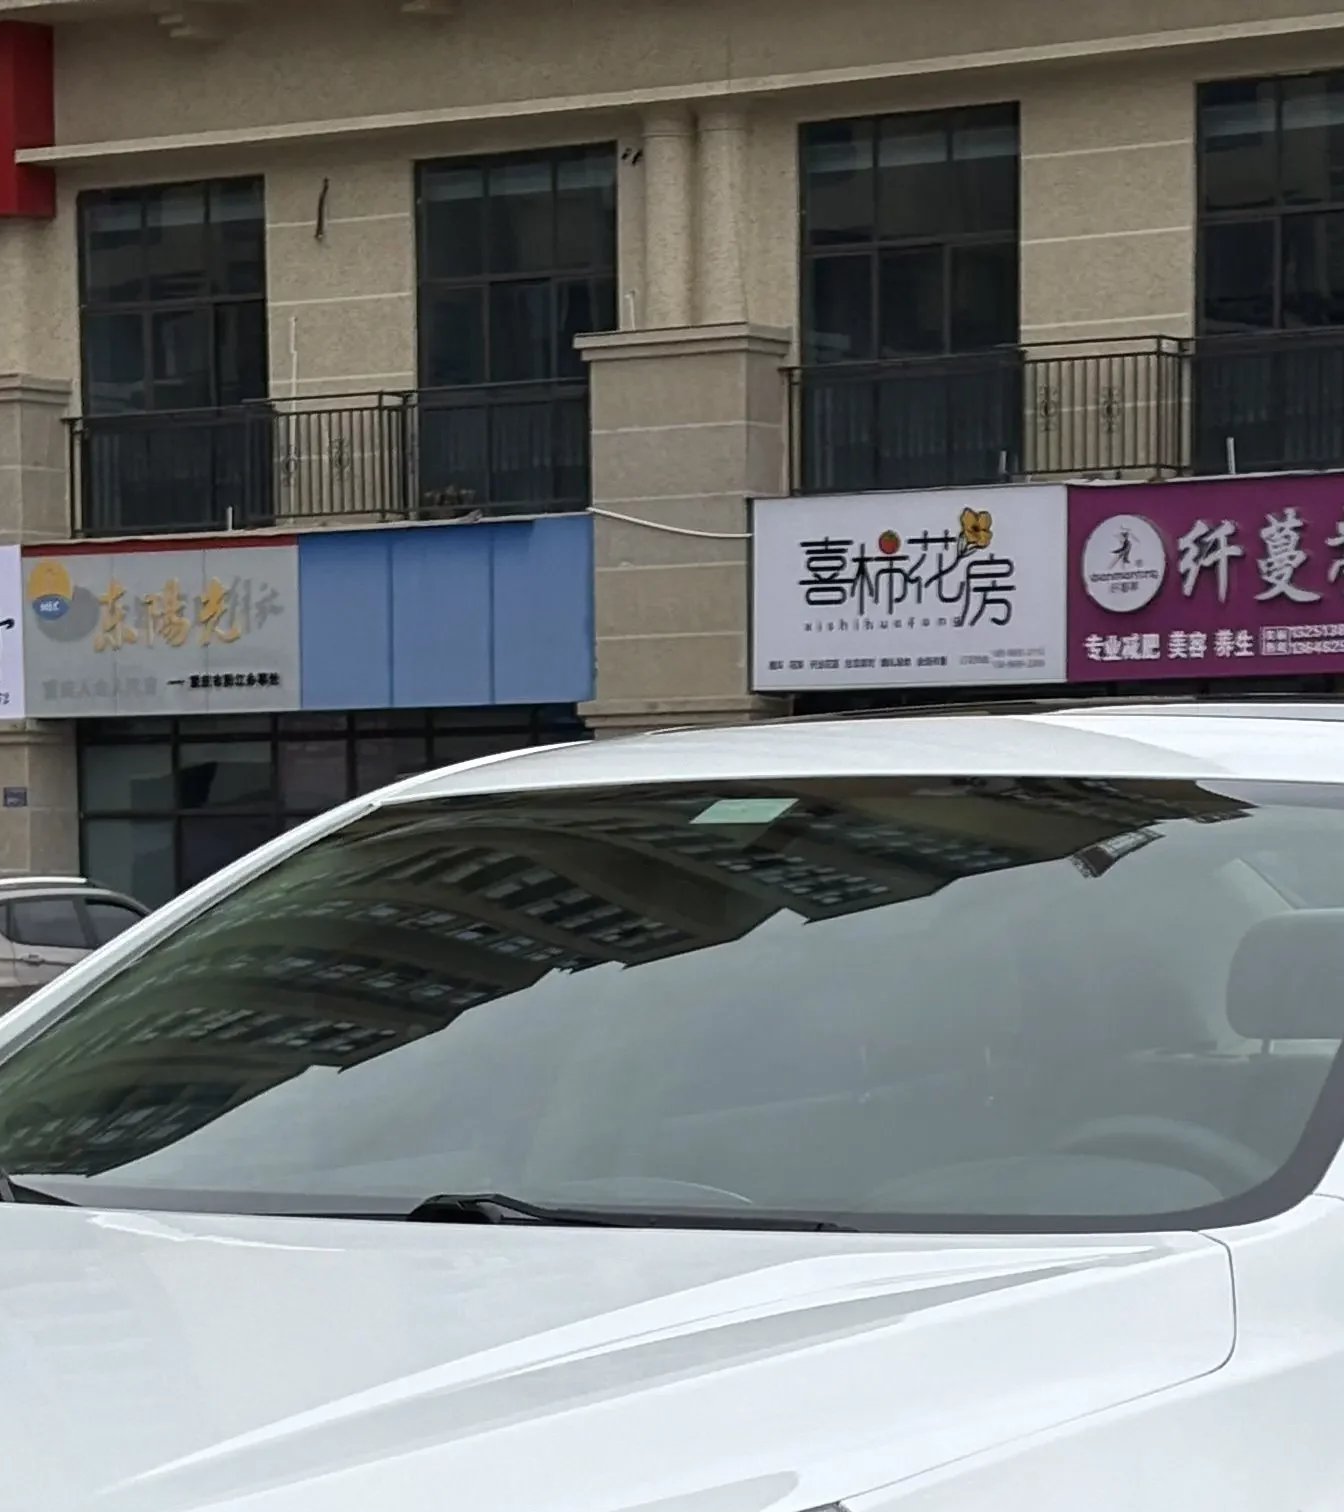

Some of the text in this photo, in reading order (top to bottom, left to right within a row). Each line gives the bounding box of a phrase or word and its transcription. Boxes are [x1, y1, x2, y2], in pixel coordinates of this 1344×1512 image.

[798, 529, 1017, 627] 喜柿花房
[1084, 633, 1161, 661] 专业减肥
[1168, 630, 1207, 659] 美容
[1214, 628, 1255, 657] 养生
